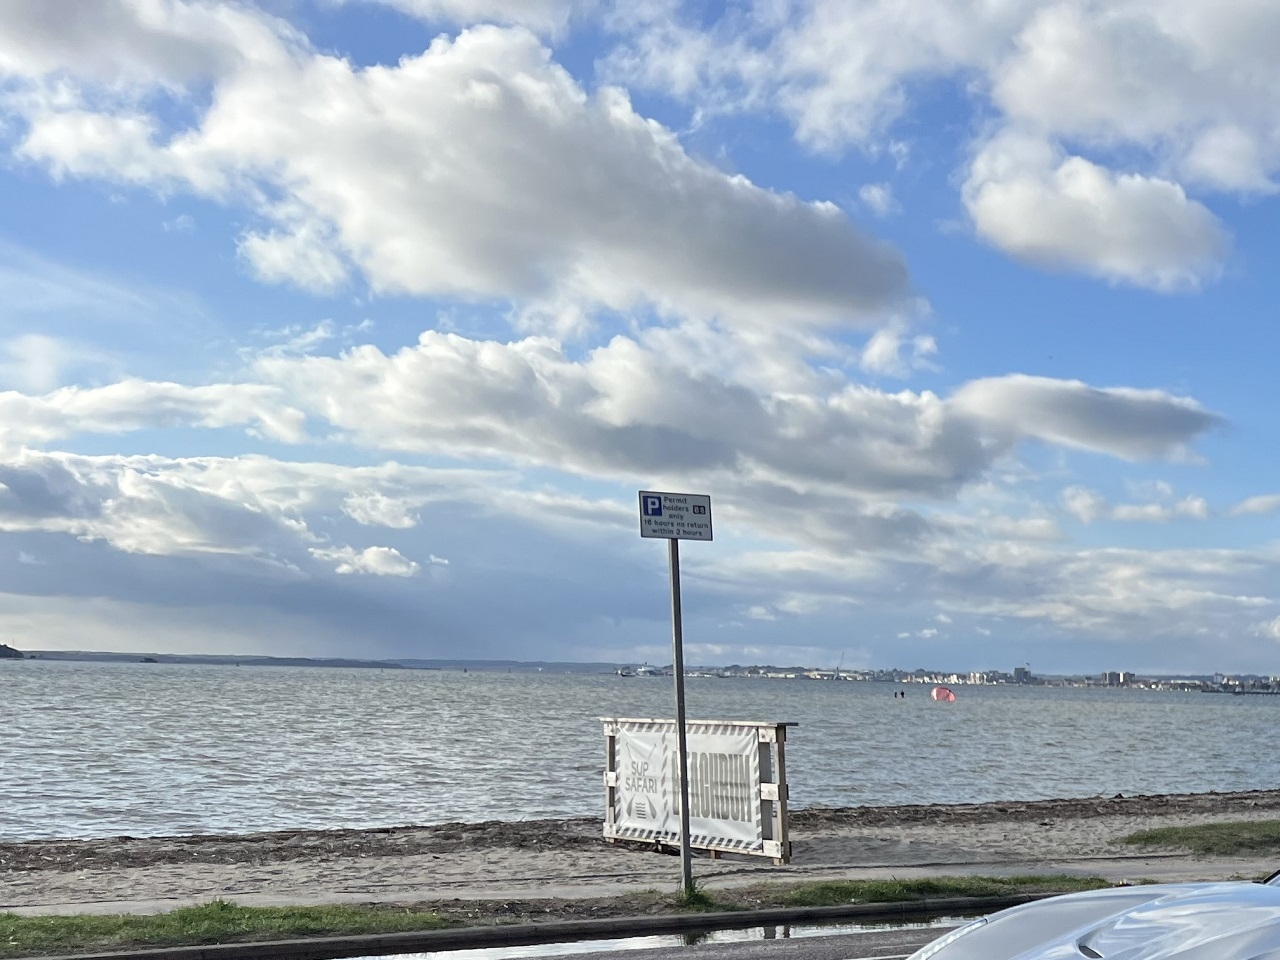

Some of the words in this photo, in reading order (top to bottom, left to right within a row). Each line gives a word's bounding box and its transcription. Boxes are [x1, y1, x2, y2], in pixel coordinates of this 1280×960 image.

[663, 504, 689, 512] holders
[654, 519, 675, 527] hours
[652, 527, 674, 535] within
[631, 761, 650, 776] SUP
[625, 777, 658, 794] SAFARI
[671, 750, 752, 823] BACHBUM
